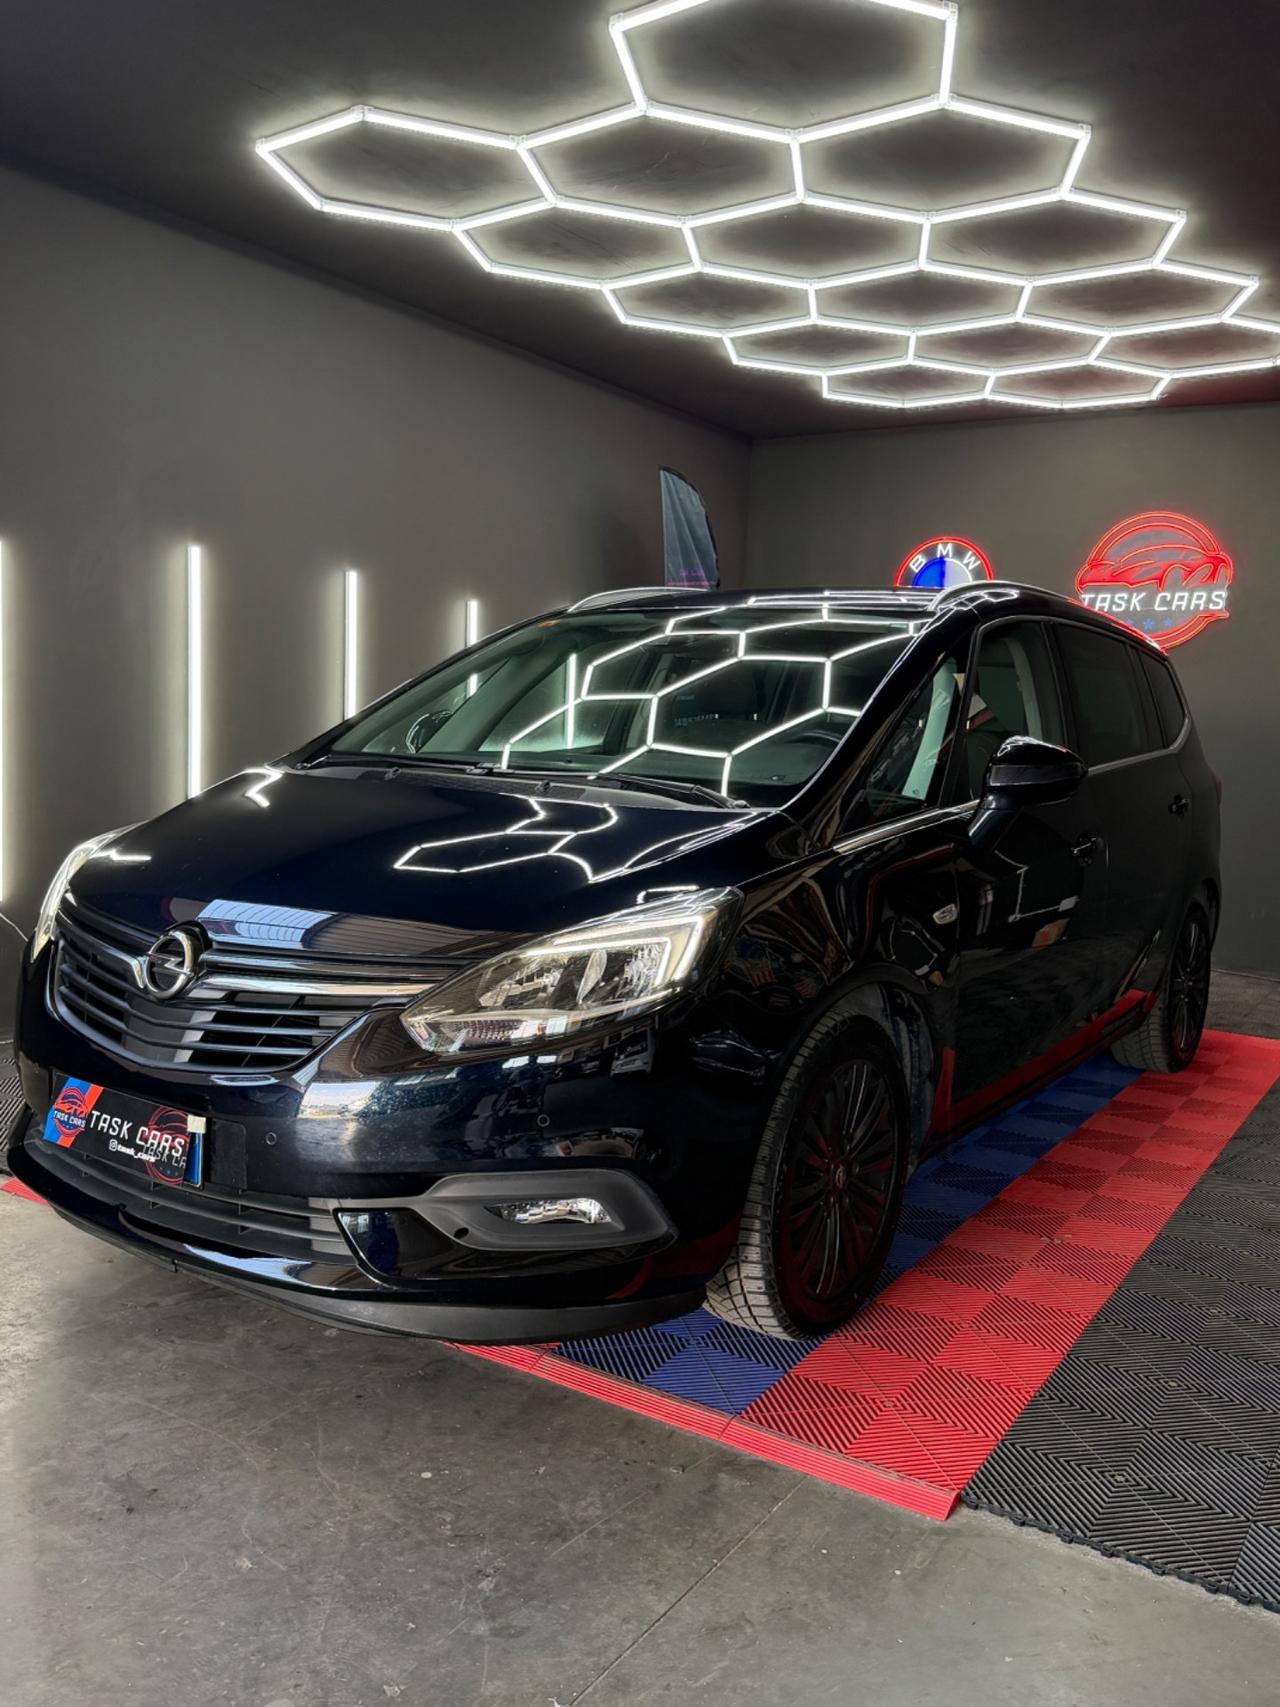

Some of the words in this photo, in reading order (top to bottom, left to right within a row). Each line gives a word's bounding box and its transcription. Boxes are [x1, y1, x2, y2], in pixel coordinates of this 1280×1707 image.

[909, 543, 981, 573] BMW
[1081, 592, 1147, 612] TASK
[1154, 591, 1226, 611] CARS
[53, 1110, 69, 1122] TASK
[69, 1116, 87, 1128] CARS
[90, 1110, 133, 1140] TASK
[136, 1126, 185, 1157] CARS
